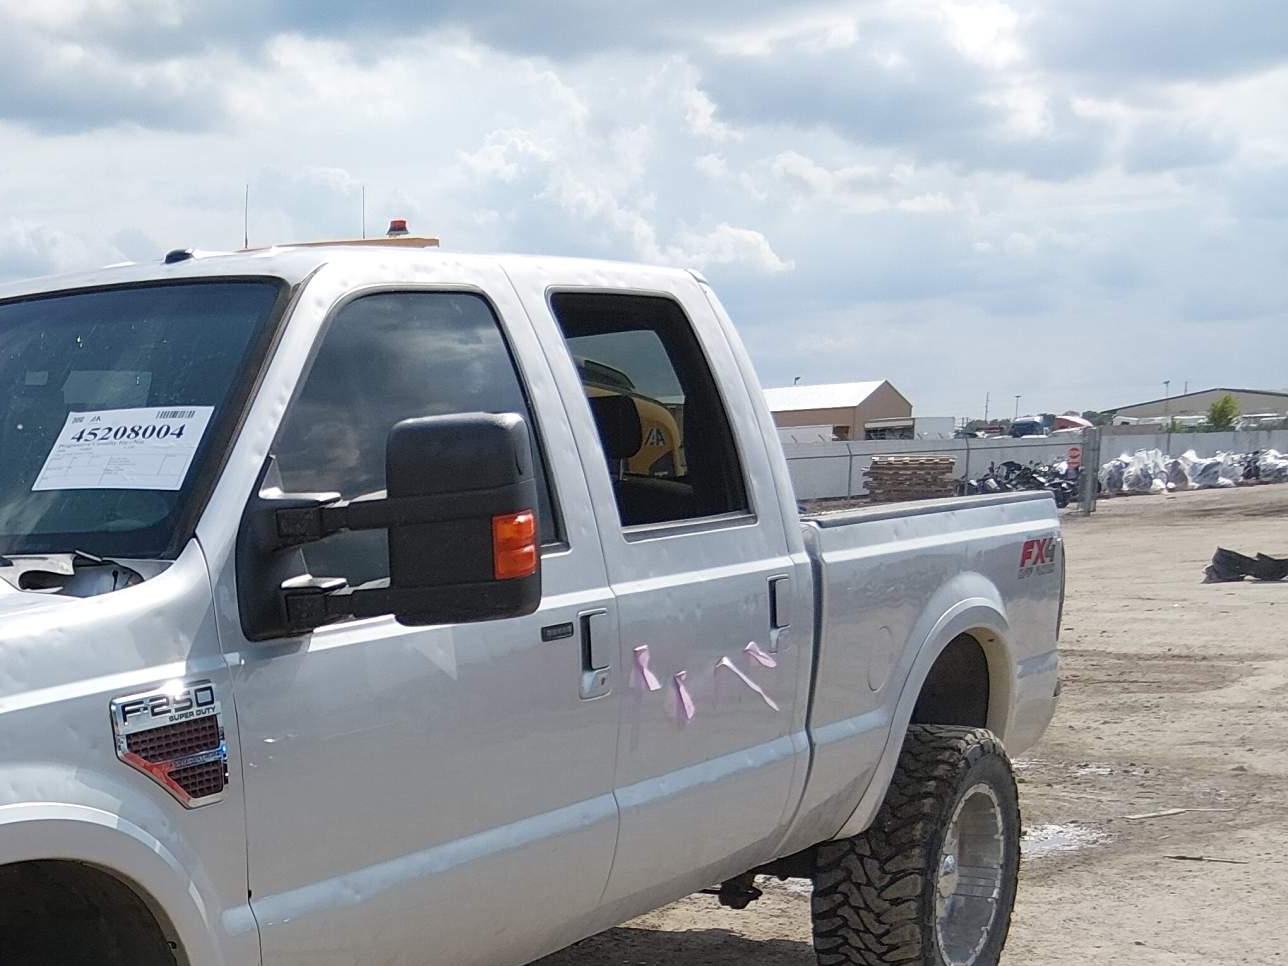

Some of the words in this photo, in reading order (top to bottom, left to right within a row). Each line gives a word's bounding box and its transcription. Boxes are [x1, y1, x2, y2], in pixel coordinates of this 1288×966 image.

[71, 423, 186, 442] 45208004
[1019, 536, 1056, 567] FX4
[168, 711, 194, 722] SUPER
[195, 705, 216, 716] DUTY
